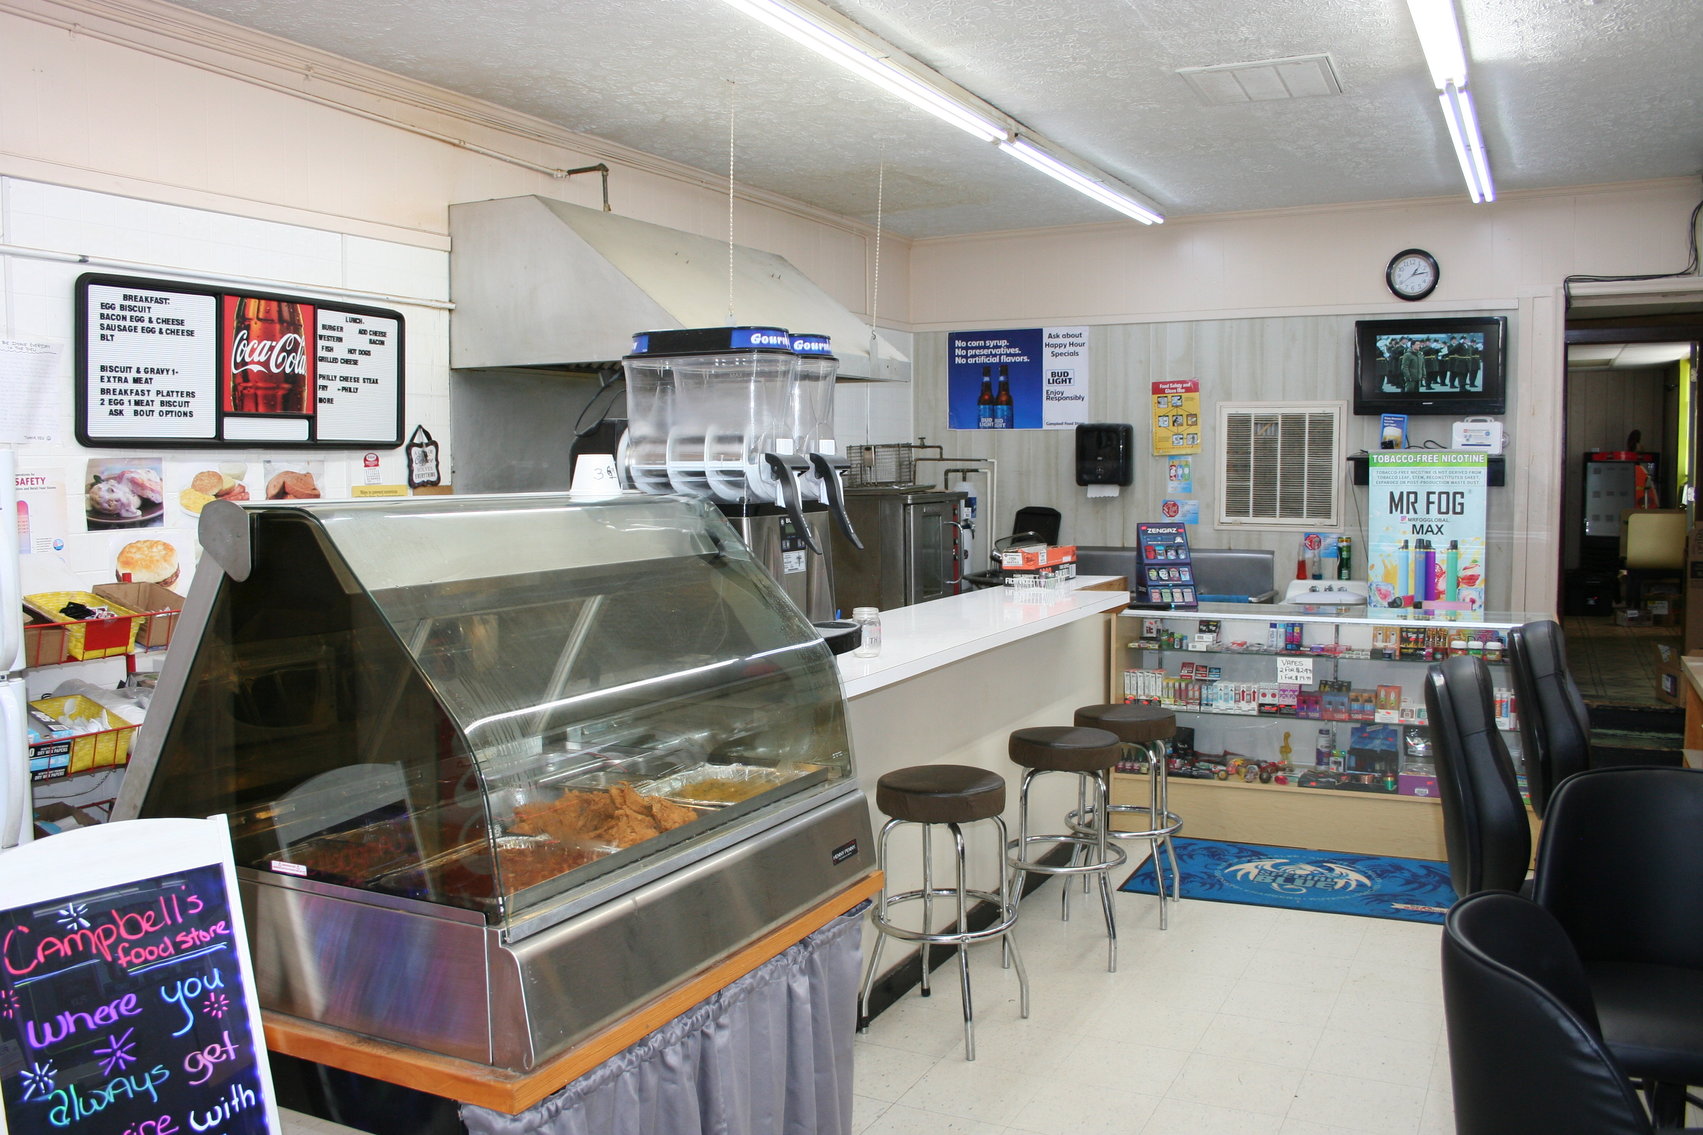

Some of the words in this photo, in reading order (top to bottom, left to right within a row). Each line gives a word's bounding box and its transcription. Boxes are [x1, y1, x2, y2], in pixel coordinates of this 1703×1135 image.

[120, 304, 151, 313] BISCUIT
[100, 313, 127, 321] BACON
[156, 317, 185, 326] CHEESE
[100, 324, 138, 333] SAUSAGE
[166, 328, 195, 336] CHEESE
[232, 330, 306, 376] Coca-Cola
[968, 347, 1021, 356] preservatives.
[156, 390, 195, 398] PLATTERS
[16, 478, 46, 486] SAFETY
[1389, 491, 1418, 514] MR
[1426, 491, 1464, 515] FOG
[1412, 524, 1444, 535] MAX
[117, 937, 175, 968] food
[176, 920, 230, 950] store
[161, 967, 224, 1037] you
[184, 1030, 239, 1085] get
[189, 1083, 256, 1131] with
